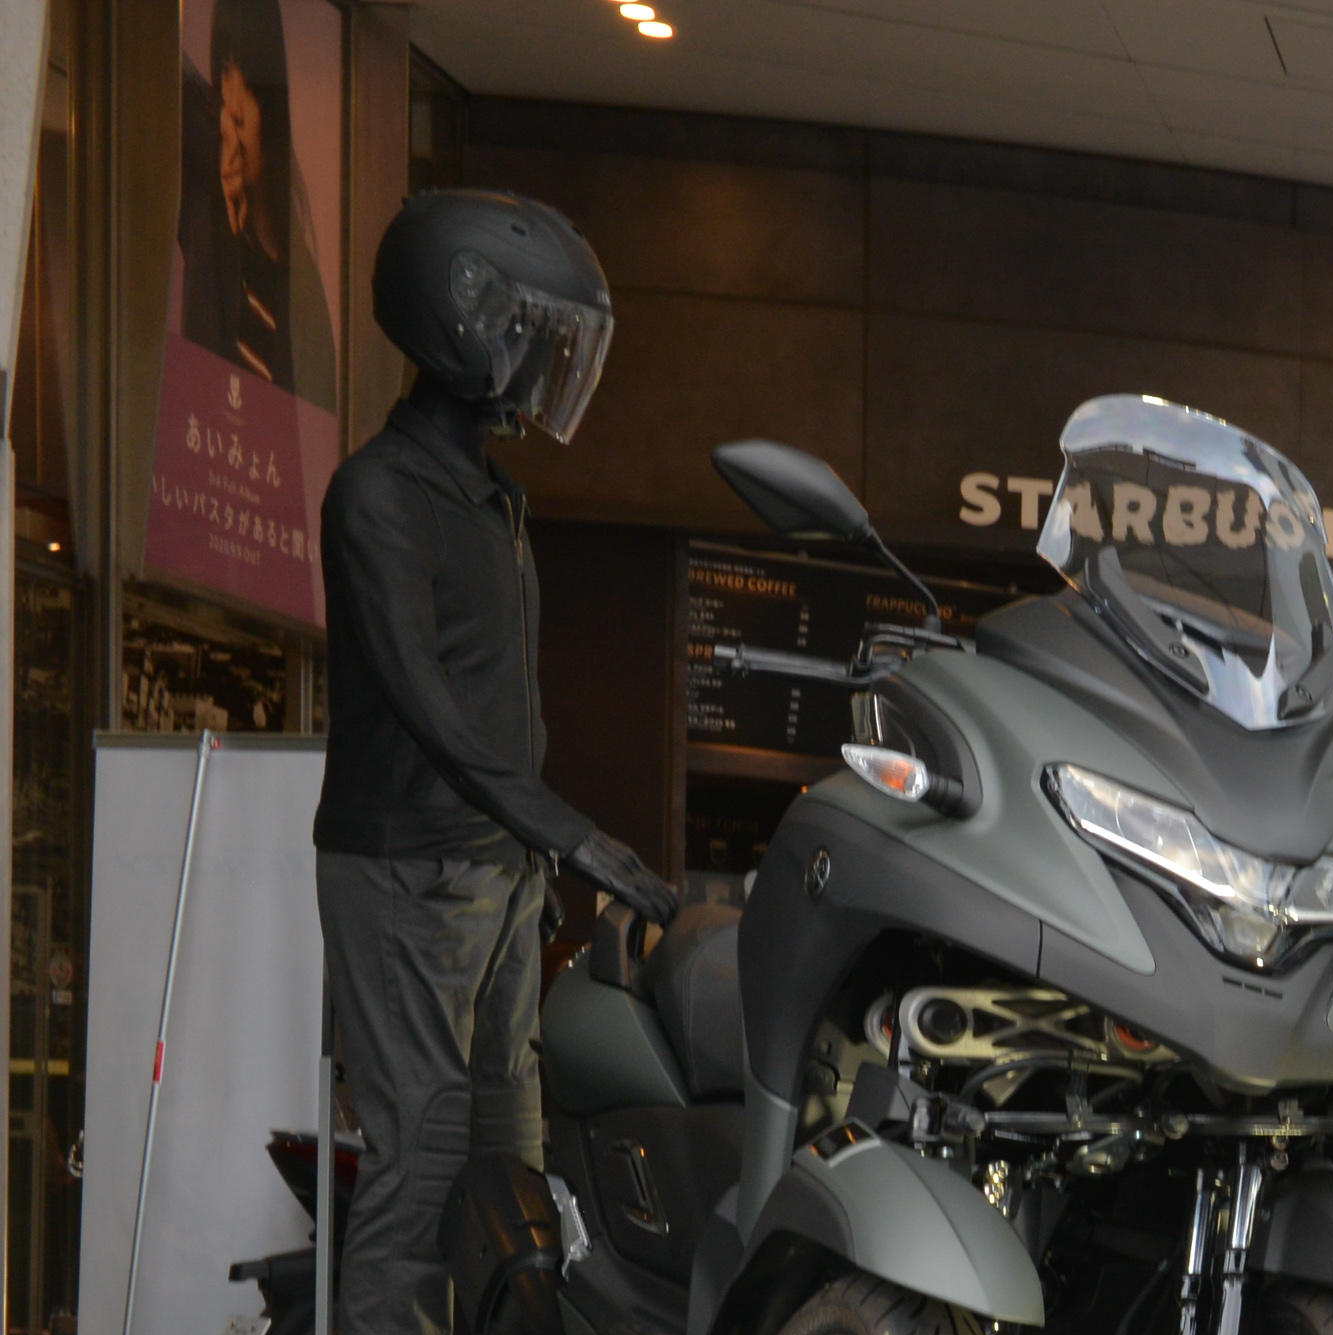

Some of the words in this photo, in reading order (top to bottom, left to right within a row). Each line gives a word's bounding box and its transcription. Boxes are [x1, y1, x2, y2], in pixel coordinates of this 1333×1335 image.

[186, 412, 281, 489] あいみょん
[747, 577, 797, 597] COFFEE
